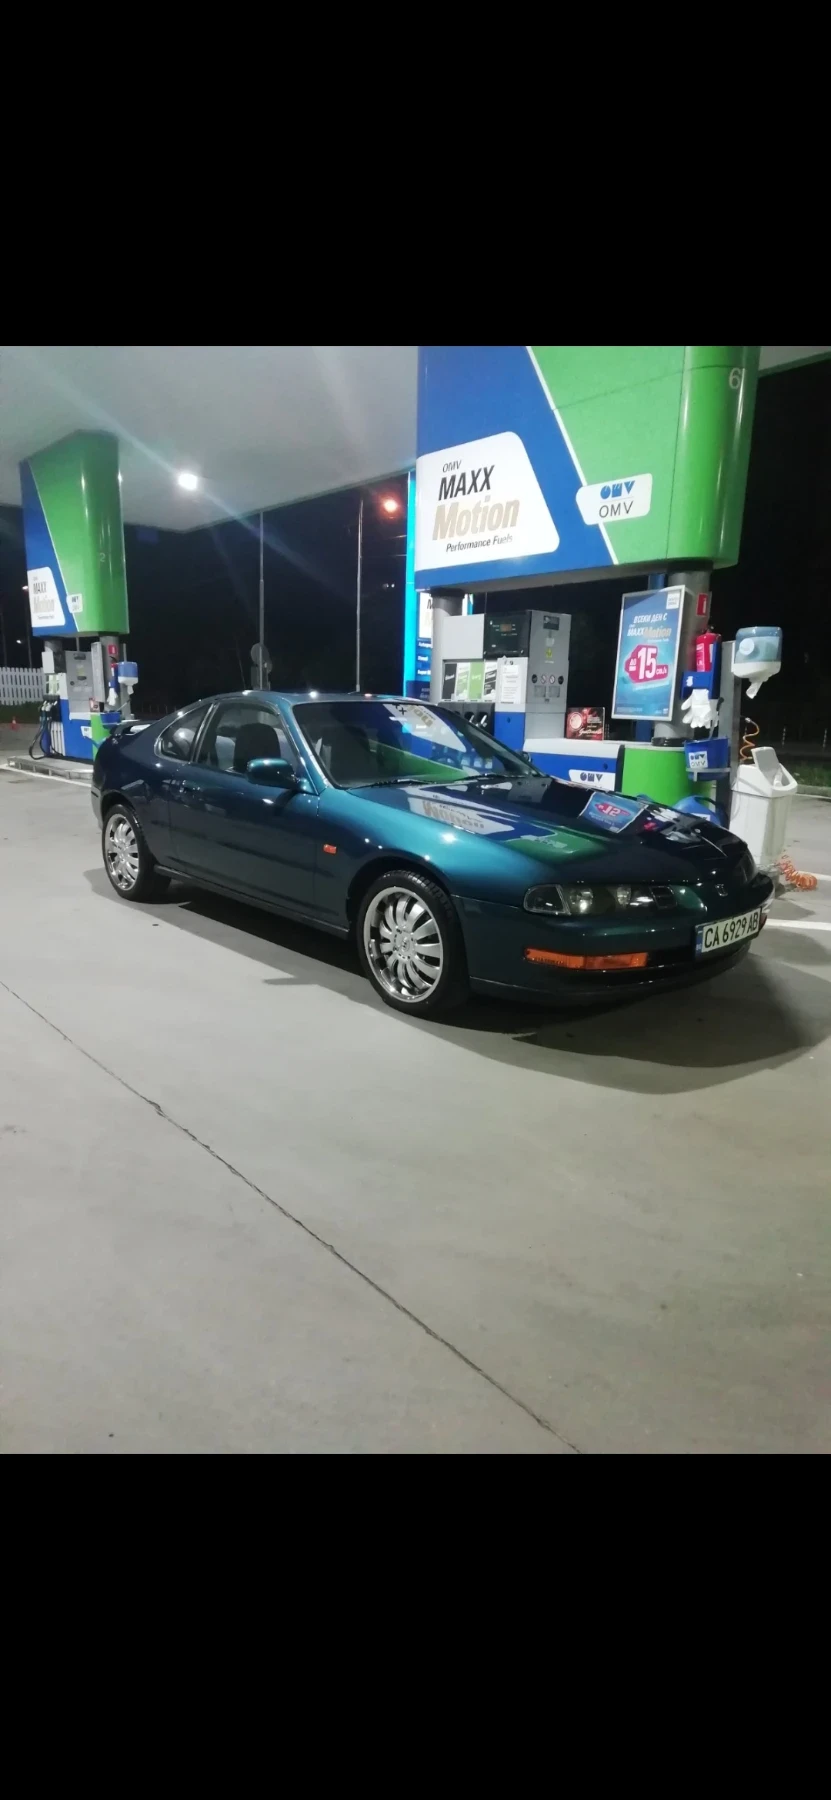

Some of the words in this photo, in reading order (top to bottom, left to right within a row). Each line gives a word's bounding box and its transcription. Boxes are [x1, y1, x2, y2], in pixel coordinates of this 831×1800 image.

[729, 368, 741, 390] 6
[442, 460, 462, 473] OMV
[438, 465, 496, 501] MAXX
[432, 495, 520, 541] Motion
[598, 501, 634, 518] OMV
[446, 540, 491, 553] Performance
[492, 534, 514, 546] Fuels
[634, 614, 650, 624] ВСЕКИ
[650, 613, 663, 623] ДЕН
[627, 627, 645, 637] MAXX
[643, 626, 672, 638] Motion
[638, 647, 657, 680] 15
[704, 926, 720, 948] CA
[722, 917, 747, 943] 6929
[747, 912, 759, 934] AB
